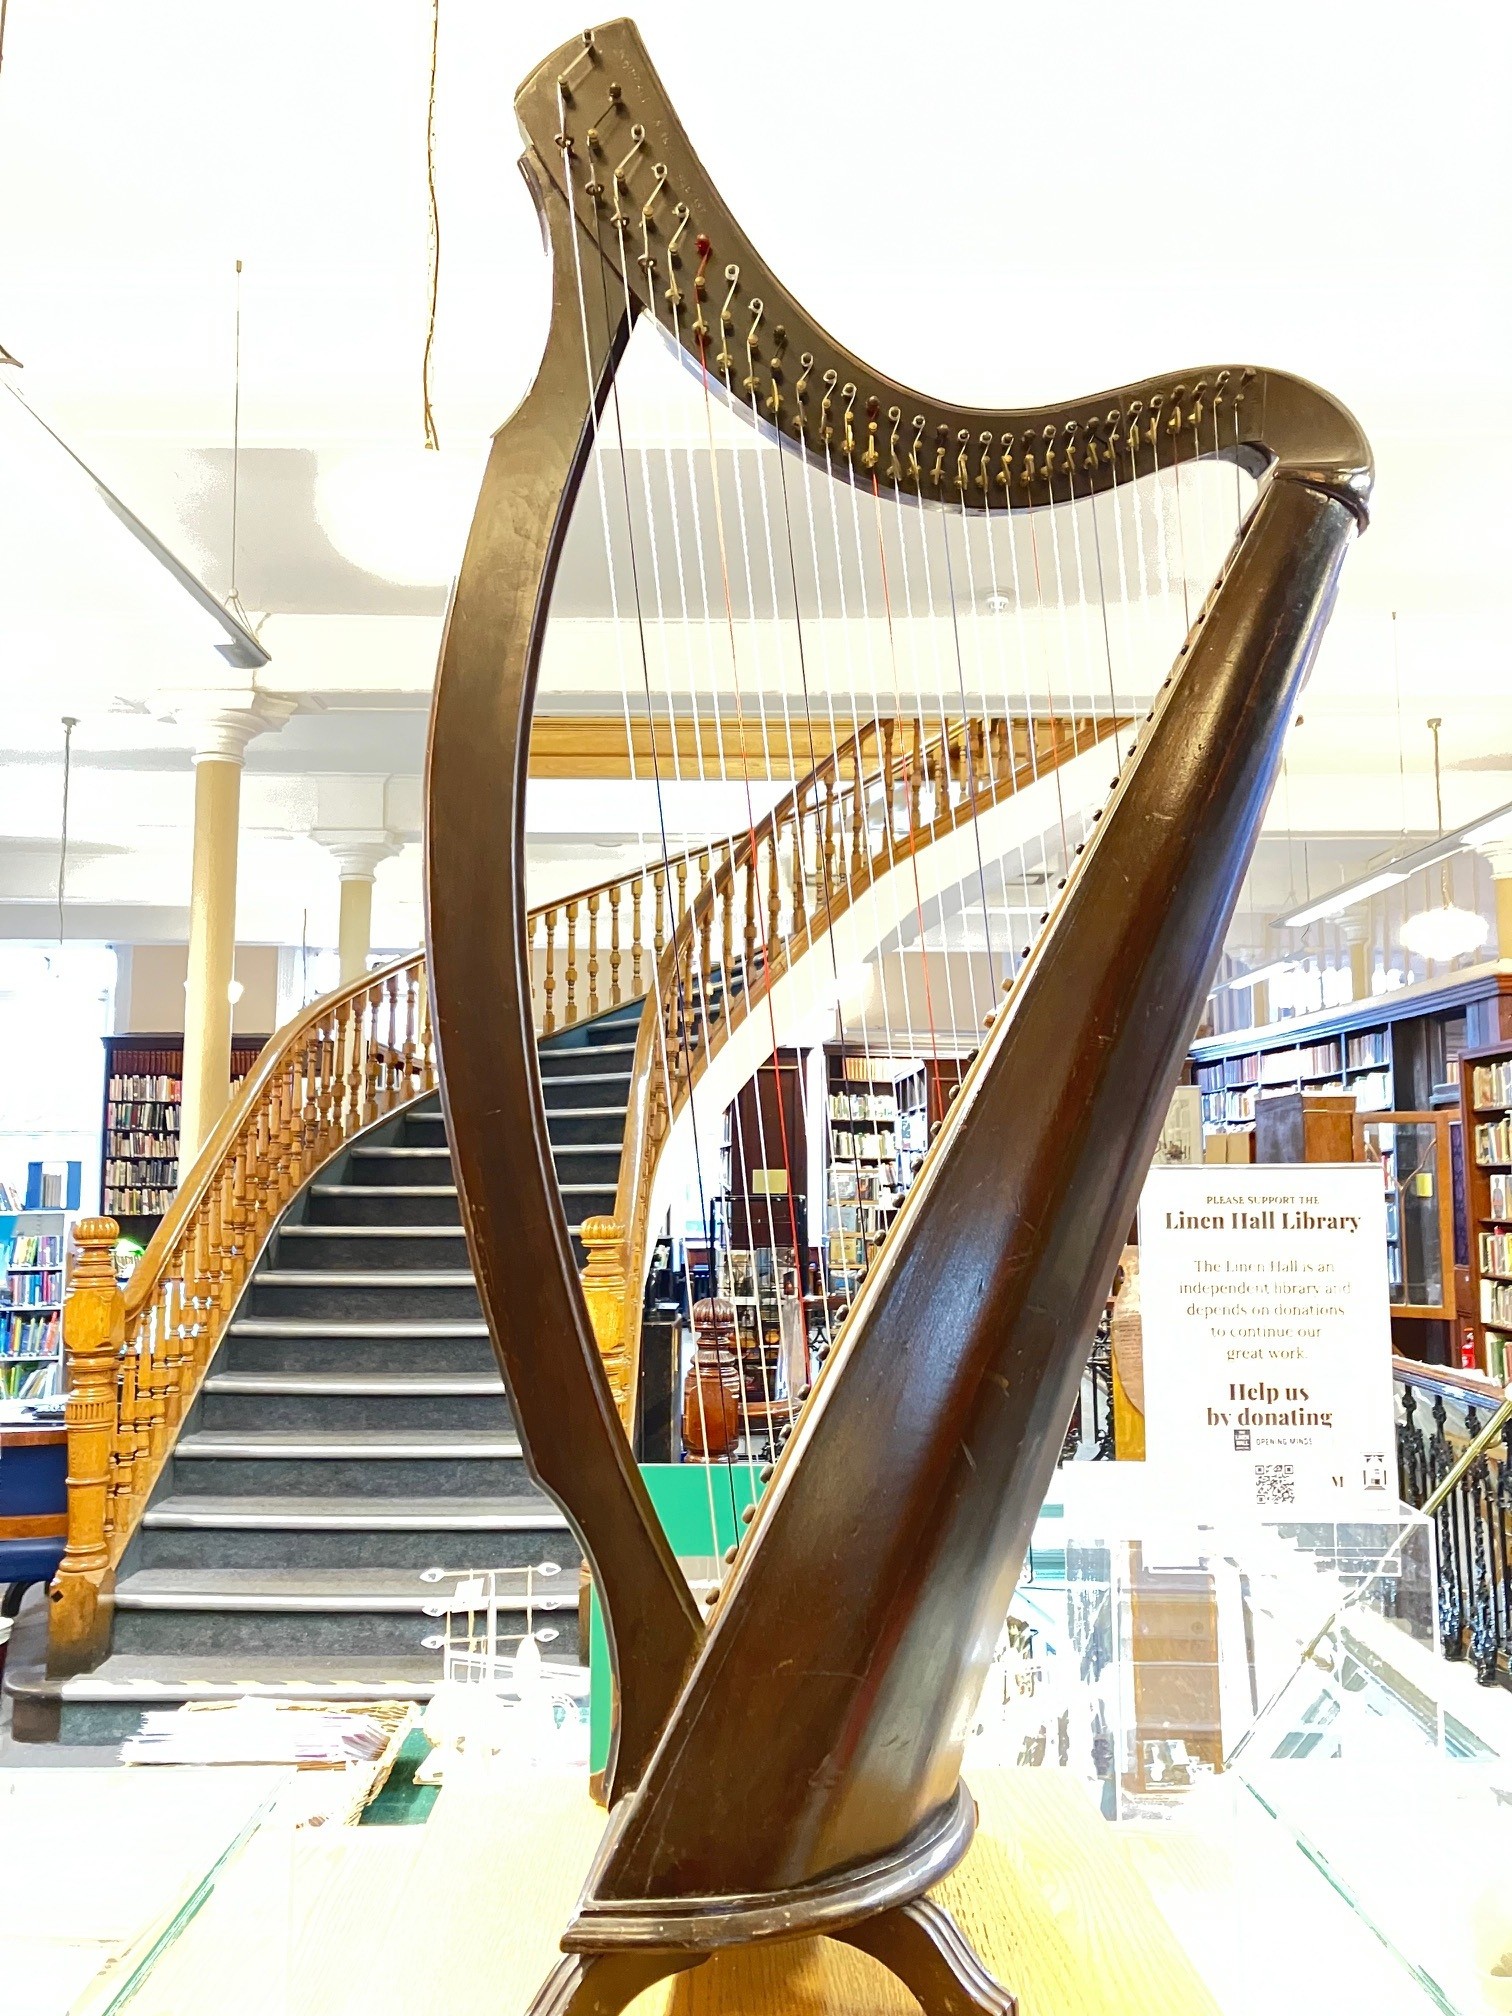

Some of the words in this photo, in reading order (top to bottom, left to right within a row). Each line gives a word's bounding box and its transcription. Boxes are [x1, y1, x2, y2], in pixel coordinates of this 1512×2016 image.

[1206, 1195, 1245, 1205] PLEASE
[1247, 1195, 1296, 1205] SUPPORT
[1298, 1195, 1320, 1205] THE
[1165, 1210, 1225, 1231] Linen
[1231, 1210, 1276, 1231] Hall
[1281, 1210, 1362, 1234] Library
[1193, 1259, 1222, 1273] The
[1226, 1259, 1265, 1273] Linen
[1270, 1259, 1298, 1273] Hall
[1301, 1260, 1314, 1273] is
[1317, 1263, 1335, 1273] an
[1179, 1281, 1270, 1298] independent
[1274, 1281, 1320, 1298] library
[1325, 1281, 1351, 1295] and
[1186, 1302, 1248, 1320] depends
[1251, 1306, 1270, 1316] on
[1274, 1303, 1345, 1316] donations
[1210, 1327, 1226, 1338] to
[1229, 1326, 1293, 1338] continue
[1297, 1328, 1322, 1338] our
[1226, 1348, 1264, 1362] great
[1268, 1346, 1308, 1360] work.
[1229, 1382, 1280, 1405] Help
[1284, 1387, 1310, 1402] us
[1237, 1407, 1333, 1430] donating
